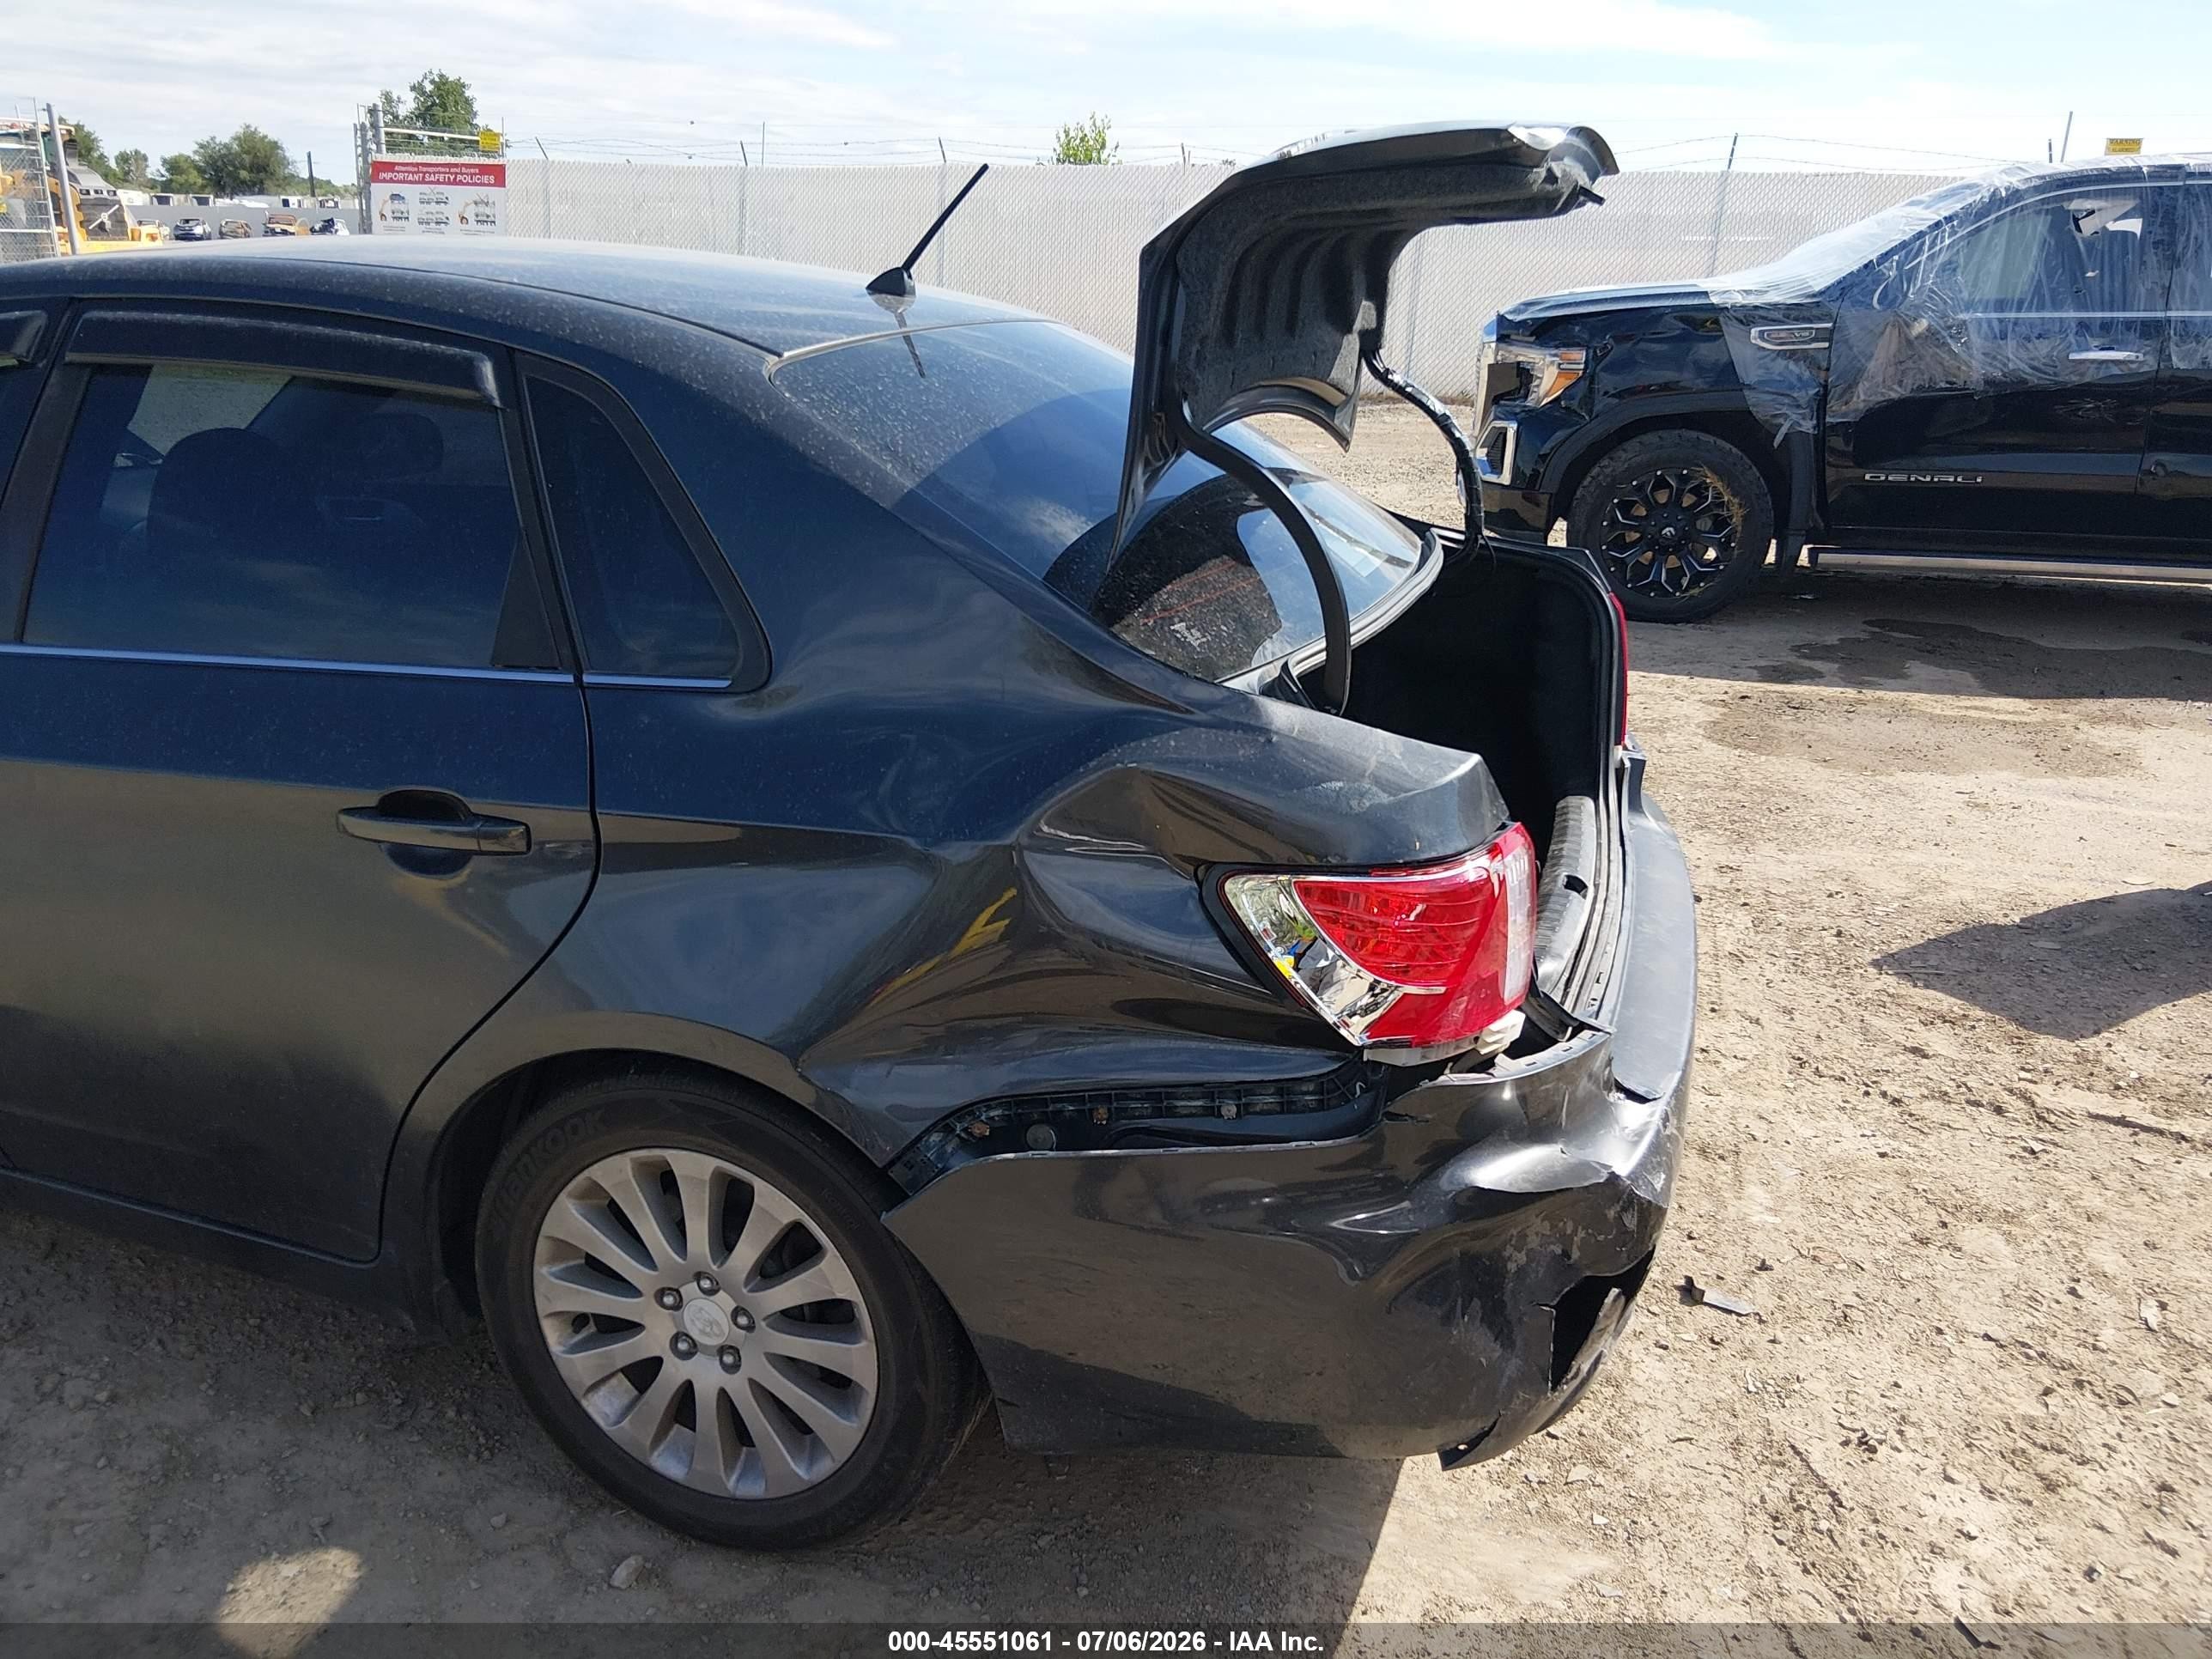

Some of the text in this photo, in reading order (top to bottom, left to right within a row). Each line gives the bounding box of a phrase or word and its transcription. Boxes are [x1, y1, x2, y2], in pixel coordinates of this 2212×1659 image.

[379, 172, 495, 184] IMPORTANT SAFETY POLICIES
[1864, 473, 1984, 483] DENALI
